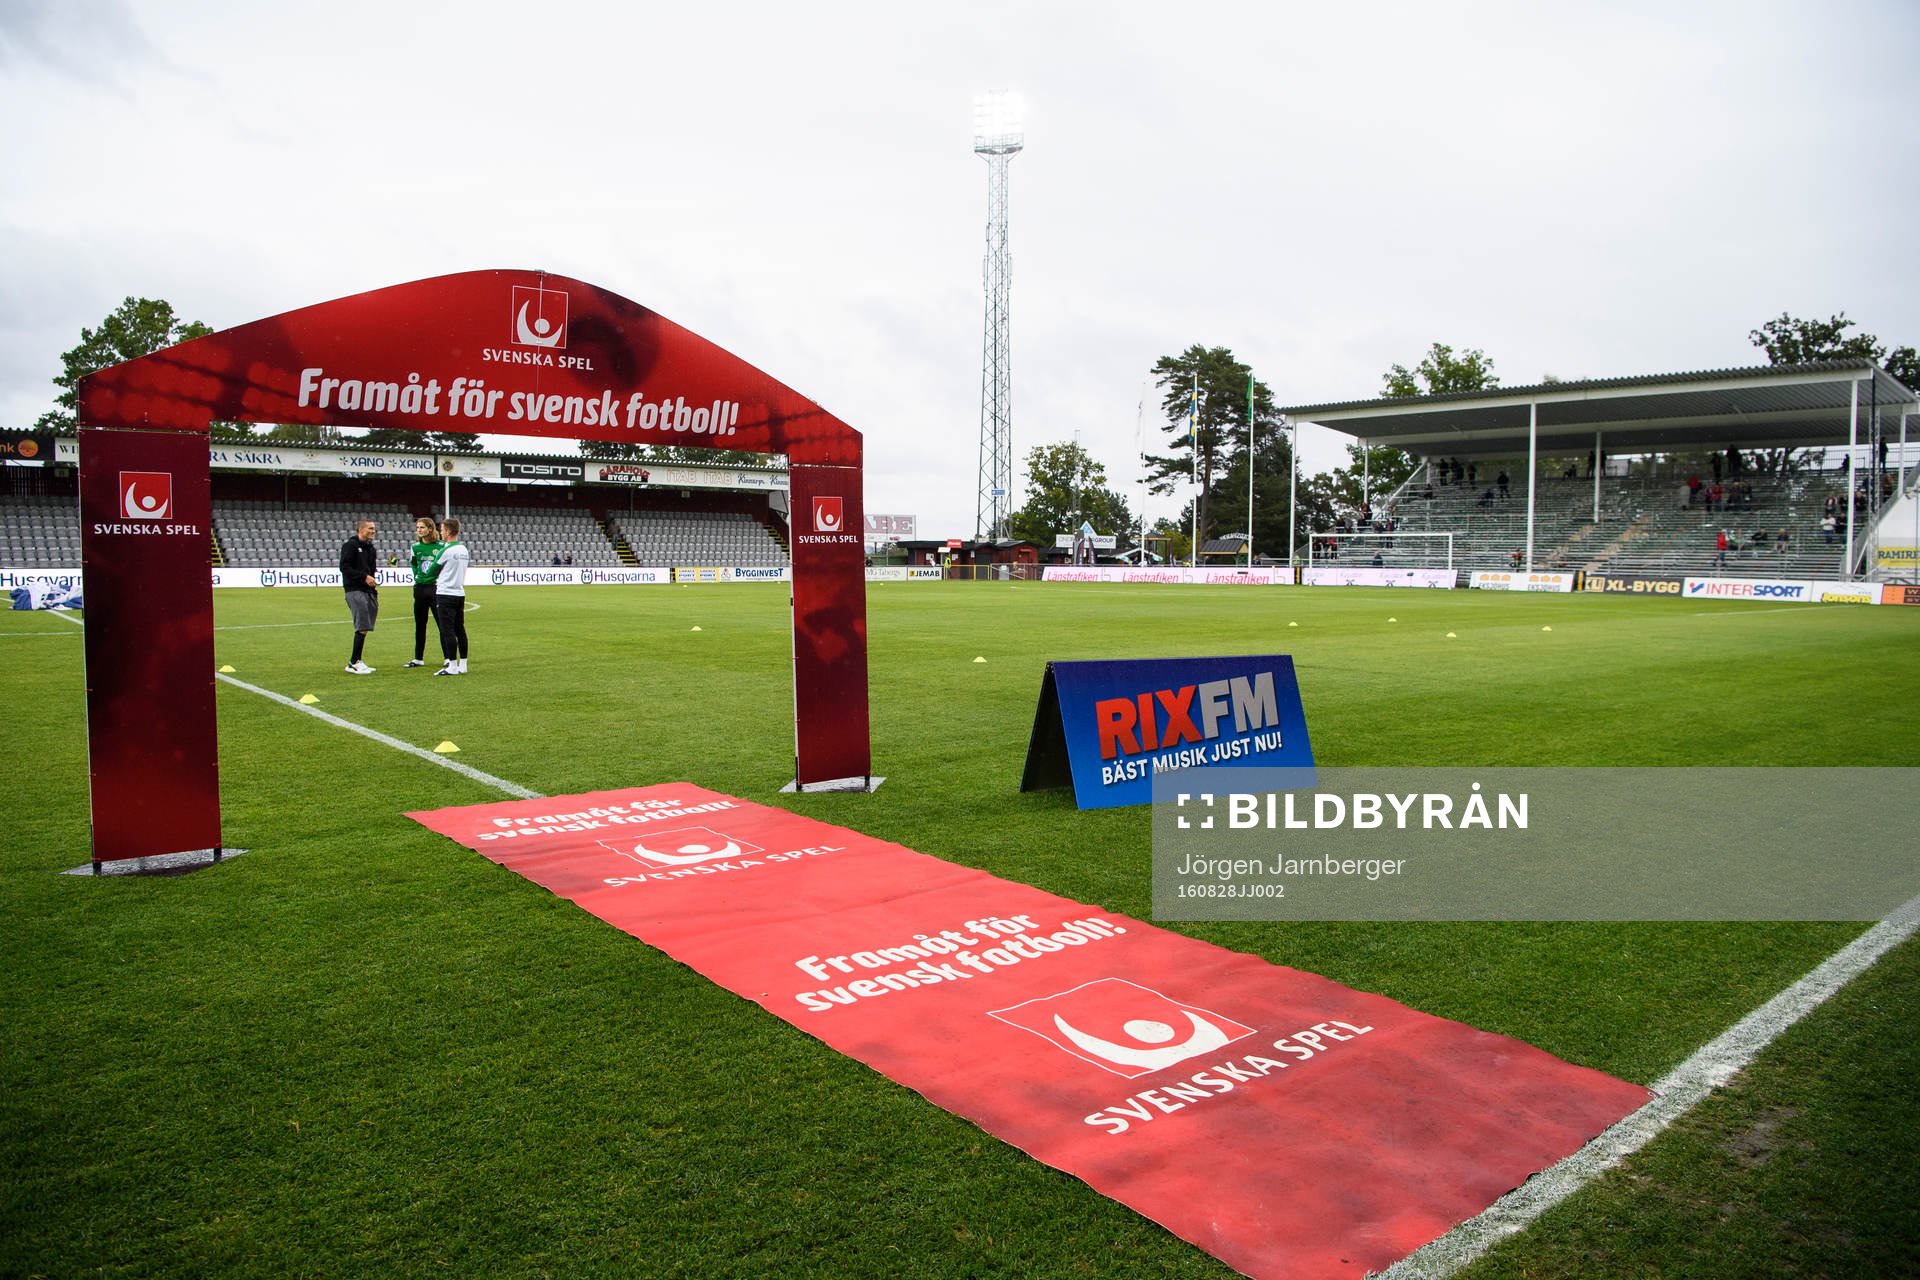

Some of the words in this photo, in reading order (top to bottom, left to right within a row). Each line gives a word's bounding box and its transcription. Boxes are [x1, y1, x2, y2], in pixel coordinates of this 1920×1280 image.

[482, 347, 553, 367] SVENSKA
[558, 355, 594, 371] SPEL
[298, 367, 442, 414] Framåt
[448, 376, 503, 419] för
[508, 389, 621, 428] svensk
[626, 391, 740, 436] fotboll!
[234, 449, 282, 465] SÄKRA
[350, 456, 385, 468] XANO
[399, 459, 432, 470] XANO
[504, 463, 582, 476] TOSITO
[607, 474, 628, 482] BYGG
[667, 469, 697, 483] ITAB
[704, 471, 732, 484] ITAB
[94, 523, 162, 535] SVENSKA
[166, 524, 200, 535] SPEL
[798, 535, 837, 544] SVENSKA
[839, 535, 859, 544] SPEL
[506, 570, 573, 584] Husqvarna
[594, 570, 656, 584] Husqvarna
[735, 567, 784, 577] BYGGINVEST
[1047, 571, 1098, 582] Länstrafiken
[1122, 570, 1179, 583] Länstrafiken
[1205, 572, 1269, 585] Länstrafiken
[1606, 579, 1681, 593] XL-BYGG
[1706, 582, 1804, 598] INTERSPORT
[1101, 759, 1148, 785] BÄST
[1152, 746, 1208, 774] MUSIK
[1211, 738, 1250, 762] JUST
[1254, 731, 1283, 753] NU!
[475, 820, 610, 841] svensk
[607, 800, 741, 825] fotboll!
[492, 806, 631, 828] Framåt
[629, 799, 681, 816] för
[602, 859, 766, 888] SVENSKA
[765, 844, 848, 863] SPEL
[795, 930, 979, 982] Framåt
[963, 913, 1040, 940] för
[795, 961, 974, 1013] svensk
[956, 917, 1128, 974] fotboll!
[1084, 1055, 1290, 1135] SVENSKA
[1272, 1020, 1375, 1061] SPEL
